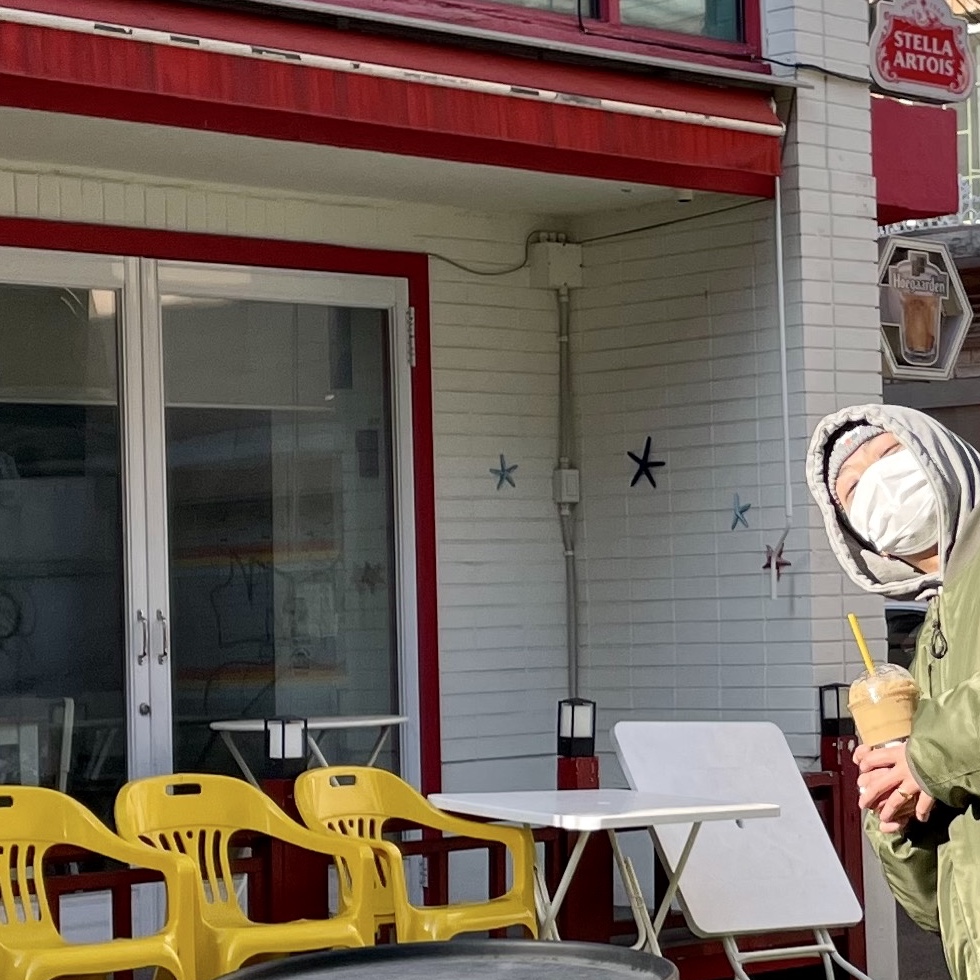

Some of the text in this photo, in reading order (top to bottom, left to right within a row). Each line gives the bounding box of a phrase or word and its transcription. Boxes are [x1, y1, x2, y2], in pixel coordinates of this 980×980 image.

[893, 31, 954, 57] STELLA
[893, 51, 955, 77] ARTOIS
[893, 272, 945, 294] Hoegaarden
